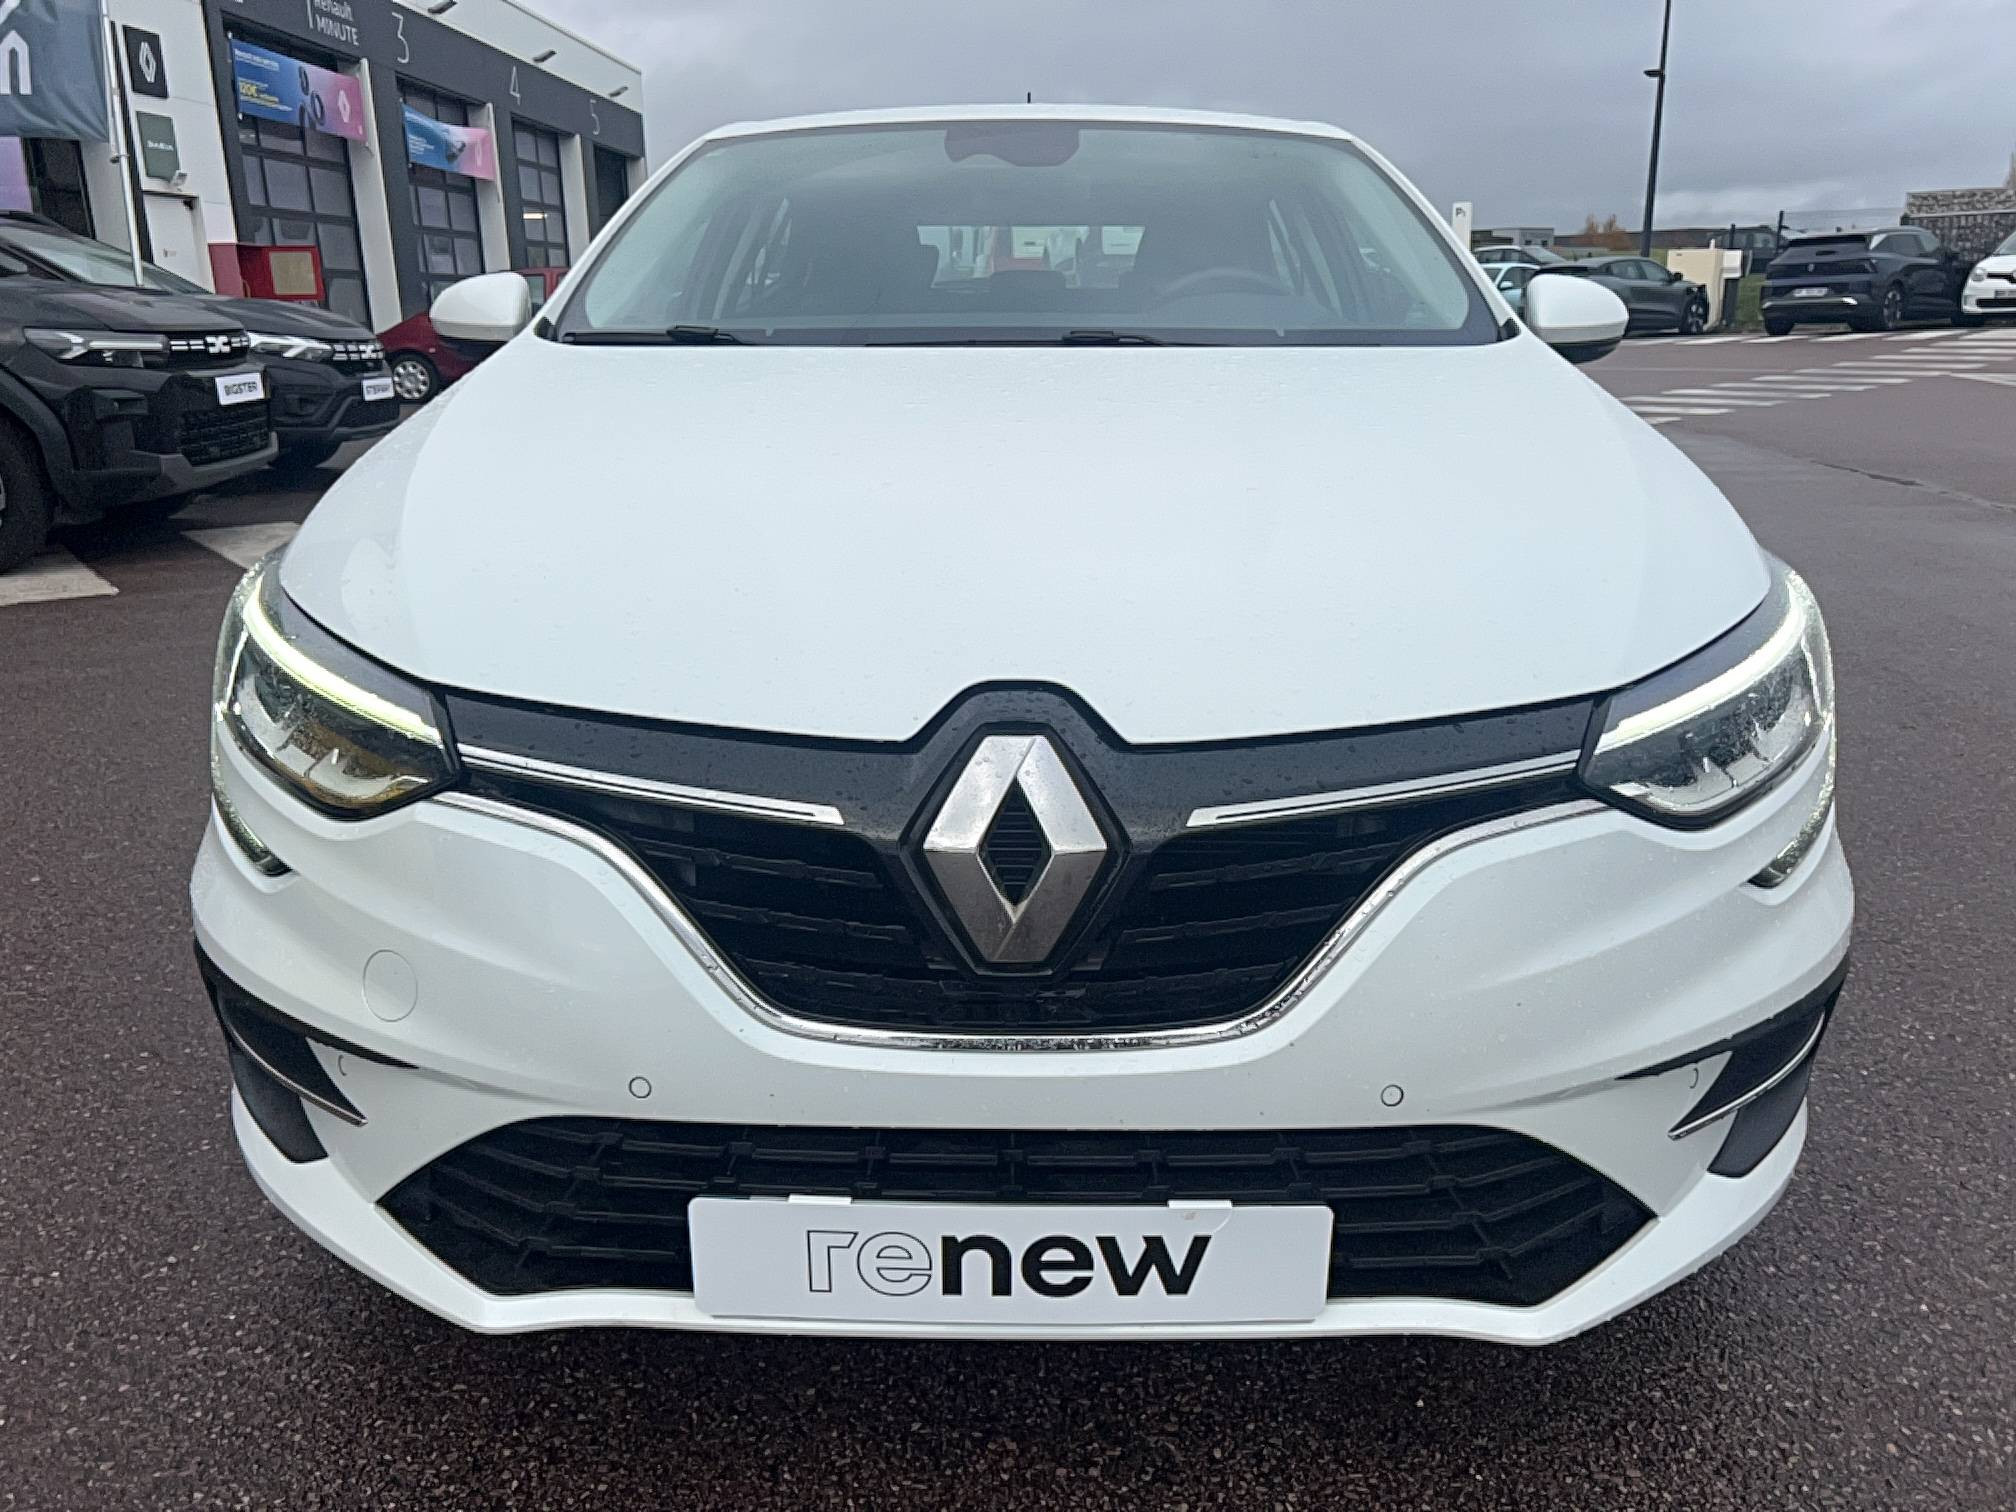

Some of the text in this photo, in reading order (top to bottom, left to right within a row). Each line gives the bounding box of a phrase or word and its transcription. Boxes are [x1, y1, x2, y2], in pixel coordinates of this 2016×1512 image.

[316, 14, 360, 46] MINUTE
[392, 12, 409, 63] 3
[510, 66, 521, 106] 4
[589, 99, 601, 135] 5
[224, 381, 257, 396] BIGSTER
[806, 1230, 1212, 1297] renew
